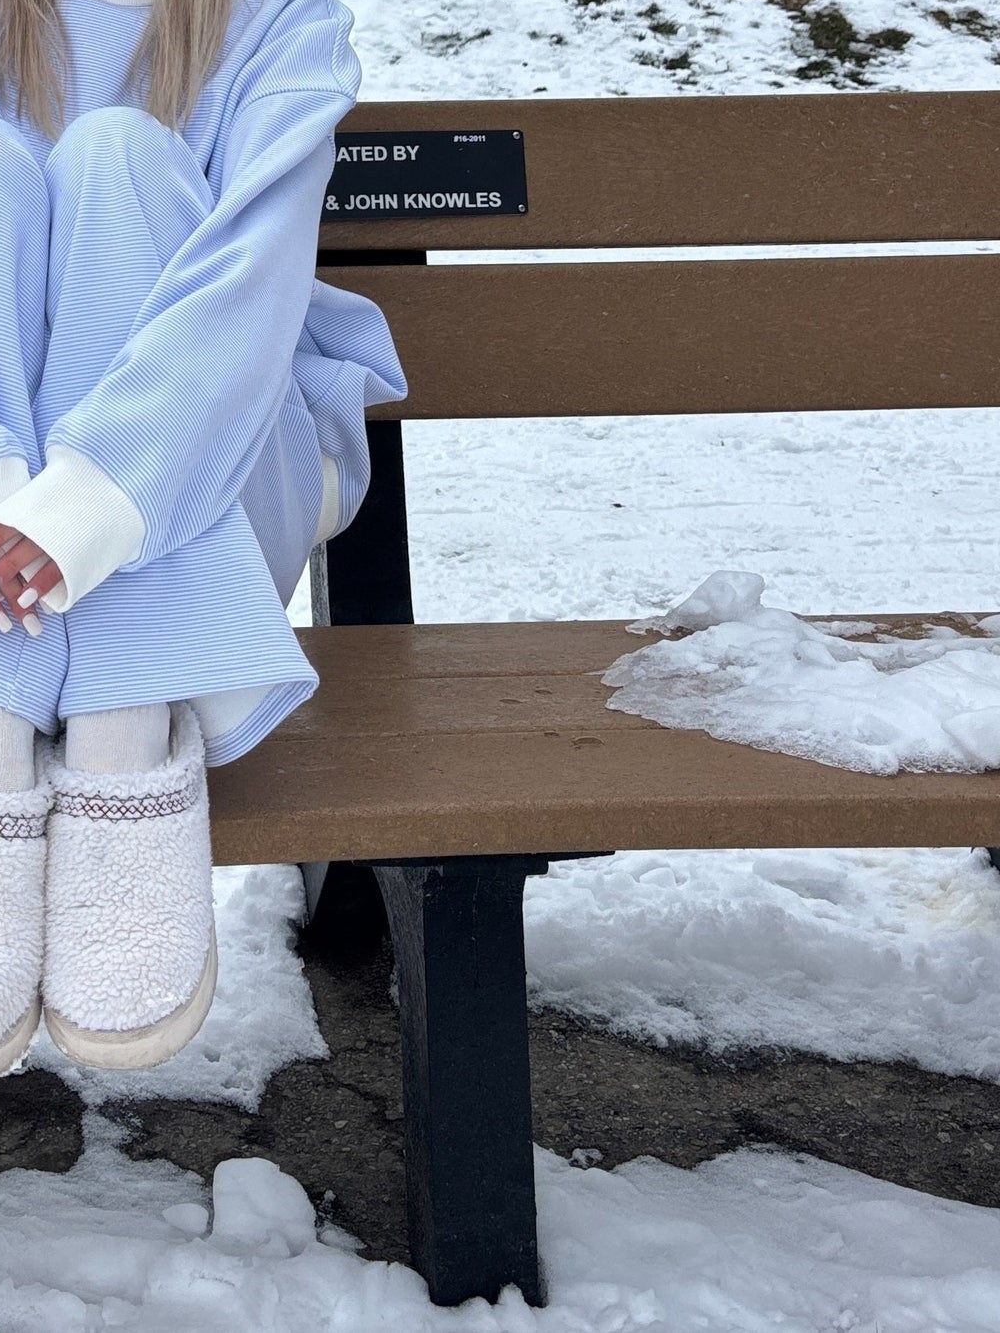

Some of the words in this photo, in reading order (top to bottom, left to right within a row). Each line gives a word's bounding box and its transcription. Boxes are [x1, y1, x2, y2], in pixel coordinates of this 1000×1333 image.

[453, 135, 486, 143] #16-2011
[393, 145, 420, 161] BY
[325, 195, 340, 210] &
[344, 194, 398, 210] JOHN
[403, 191, 502, 209] KNOWLES
